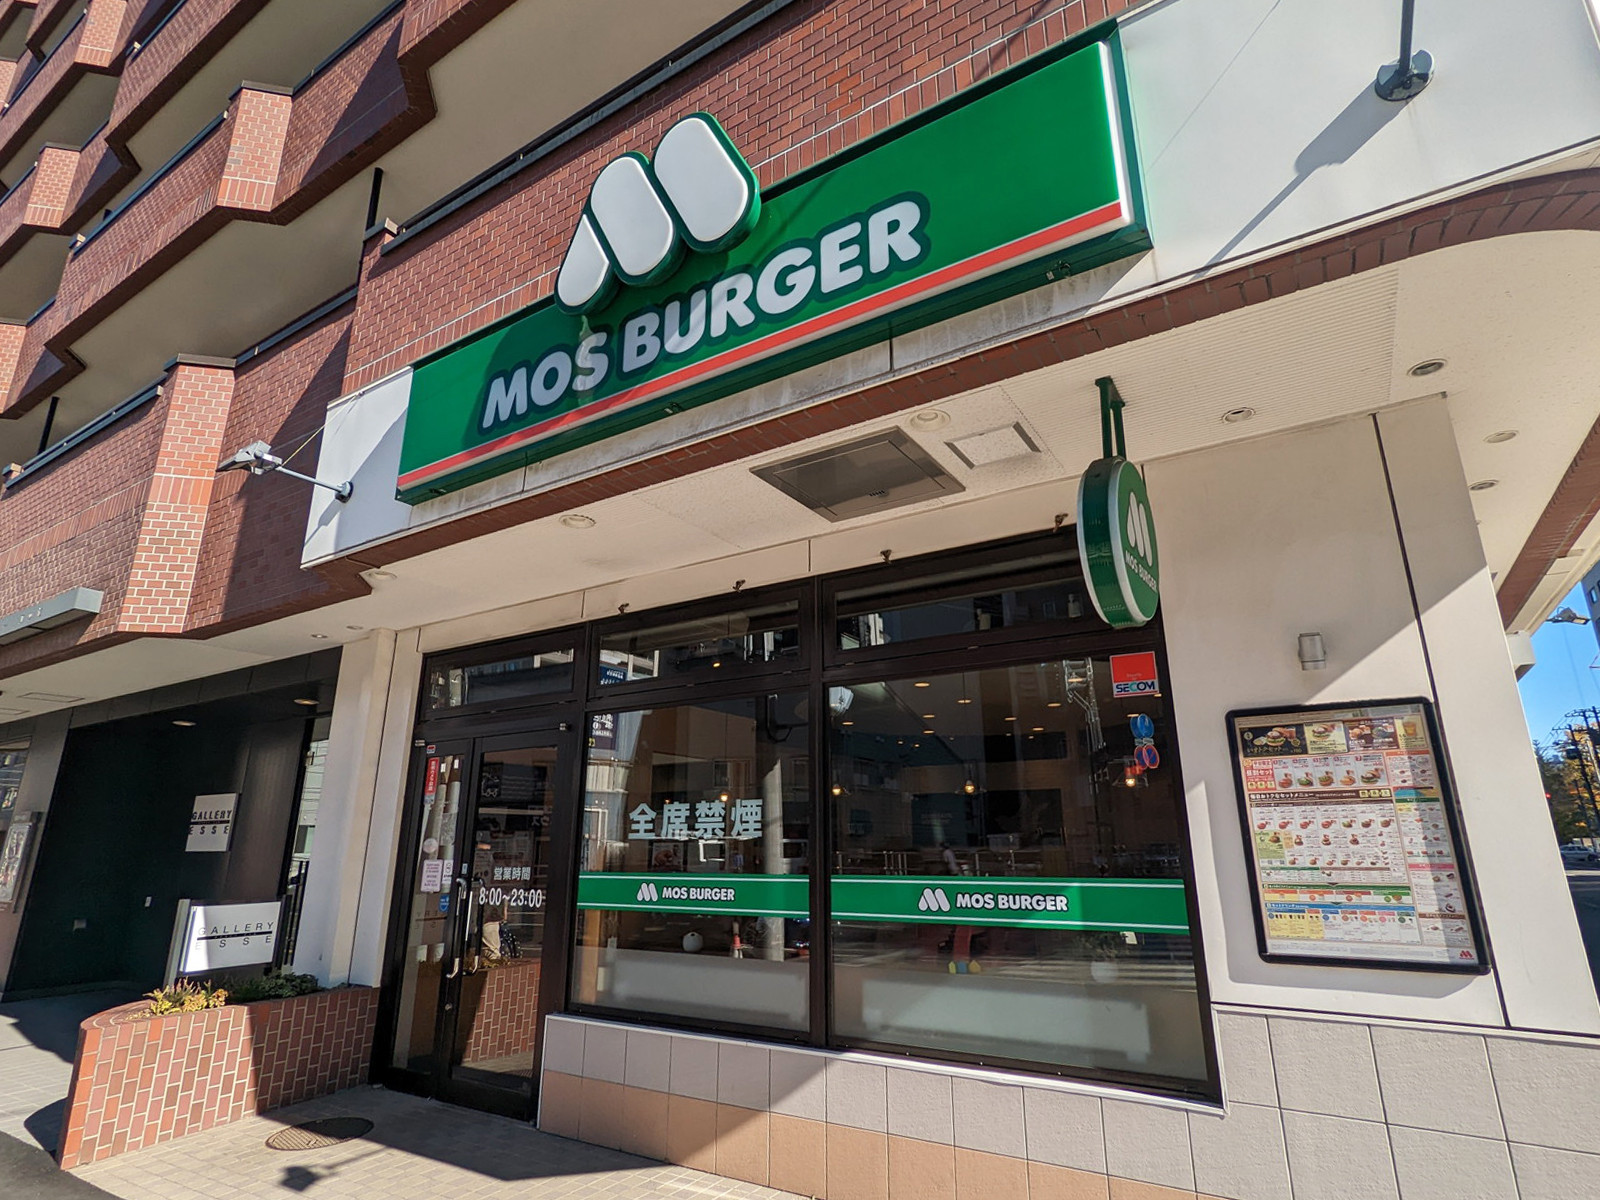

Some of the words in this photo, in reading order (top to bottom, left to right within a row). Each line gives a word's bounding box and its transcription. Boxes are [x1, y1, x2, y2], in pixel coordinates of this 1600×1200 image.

[481, 330, 610, 429] MOS
[621, 200, 922, 374] BURGER
[1125, 550, 1138, 574] MOS
[1138, 564, 1158, 594] BURGER
[1115, 681, 1156, 693] SECOM
[192, 810, 232, 820] GALLERY
[628, 798, 763, 839] 全席禁煙
[188, 825, 229, 835] ESSE
[493, 866, 531, 881] 営業時間
[661, 887, 688, 900] MOS
[689, 887, 736, 901] BURGER
[956, 893, 995, 909] MOS
[997, 894, 1068, 912] BURGER
[198, 922, 274, 936] GALLERY
[195, 936, 272, 951] ESSE
